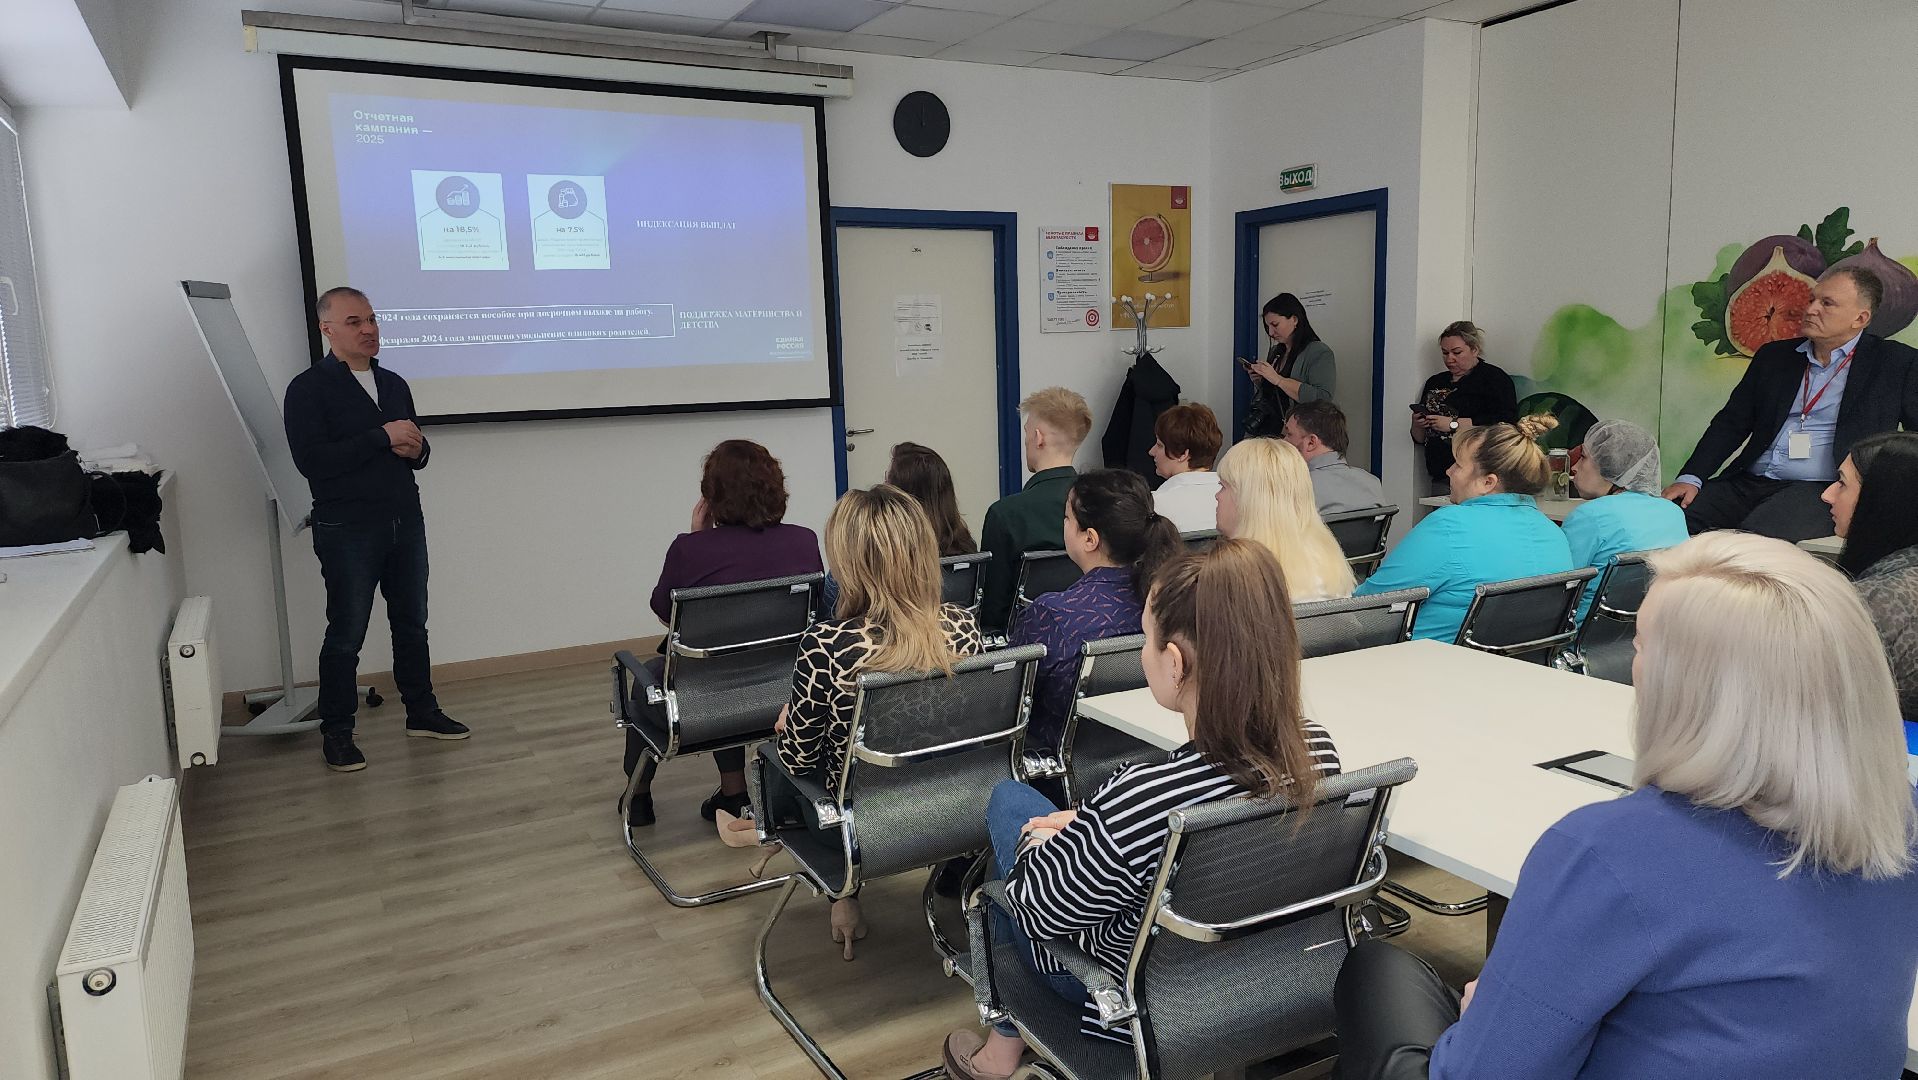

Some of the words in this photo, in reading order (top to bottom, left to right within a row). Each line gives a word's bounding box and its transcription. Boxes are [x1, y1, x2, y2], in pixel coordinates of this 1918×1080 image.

[353, 110, 414, 122] Отчетная
[355, 123, 419, 134] кампания
[356, 133, 385, 144] 2025
[1280, 169, 1313, 186] ВЫХОД
[636, 220, 699, 229] ИНДЕКСАЦИЯ
[700, 221, 736, 230] ВЫПЛАТ
[375, 313, 398, 322] 2024
[423, 312, 480, 322] сохраняется
[481, 310, 516, 319] пособие
[518, 311, 535, 319] при
[679, 311, 733, 319] ПОДДЕРЖКА
[735, 310, 794, 318] МАТЕРИНСТВА
[679, 320, 719, 329] ДЕТСТВА
[421, 334, 442, 343] 2024
[444, 333, 465, 342] года
[467, 332, 515, 342] запрещено
